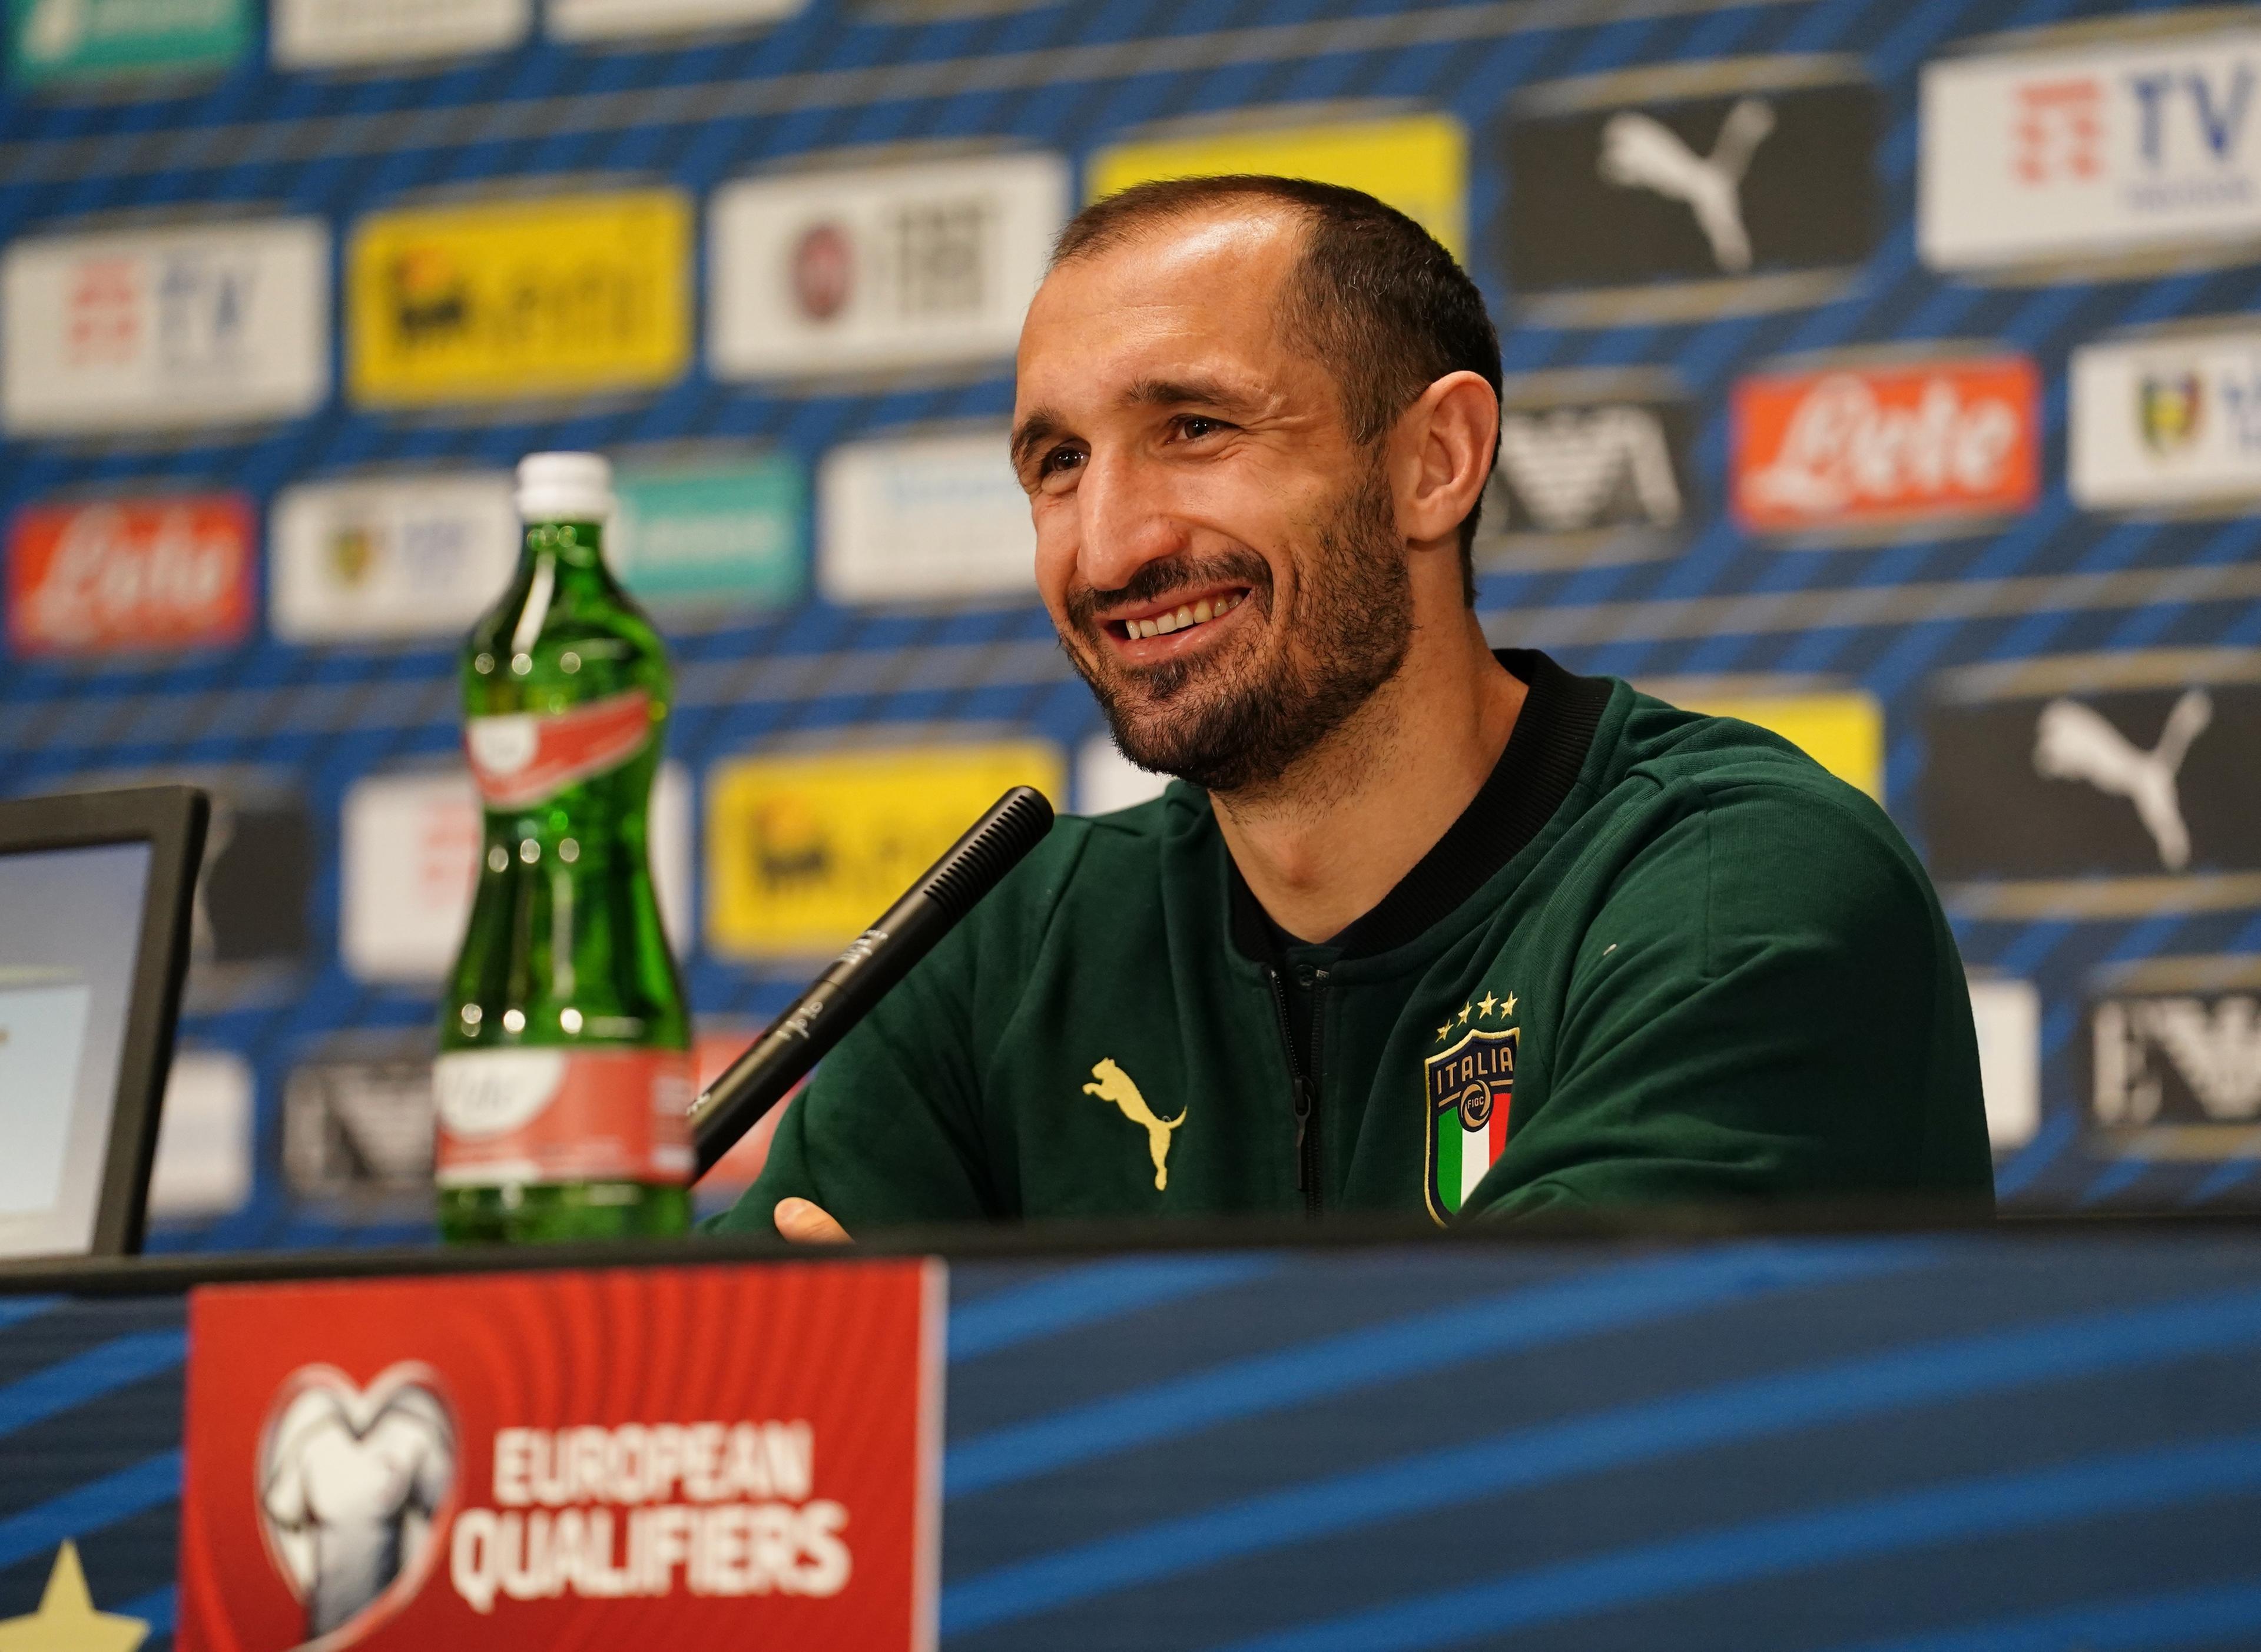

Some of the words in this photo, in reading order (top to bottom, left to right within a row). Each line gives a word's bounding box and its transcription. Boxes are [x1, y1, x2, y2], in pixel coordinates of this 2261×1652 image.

[2129, 66, 2256, 166] TV
[1734, 372, 2018, 511] Lete
[1437, 1046, 1514, 1095] ITALIA
[1467, 1096, 1484, 1110] FIGC
[492, 1418, 814, 1507] EUROPEAN
[450, 1498, 854, 1615] QUALIFIERS
